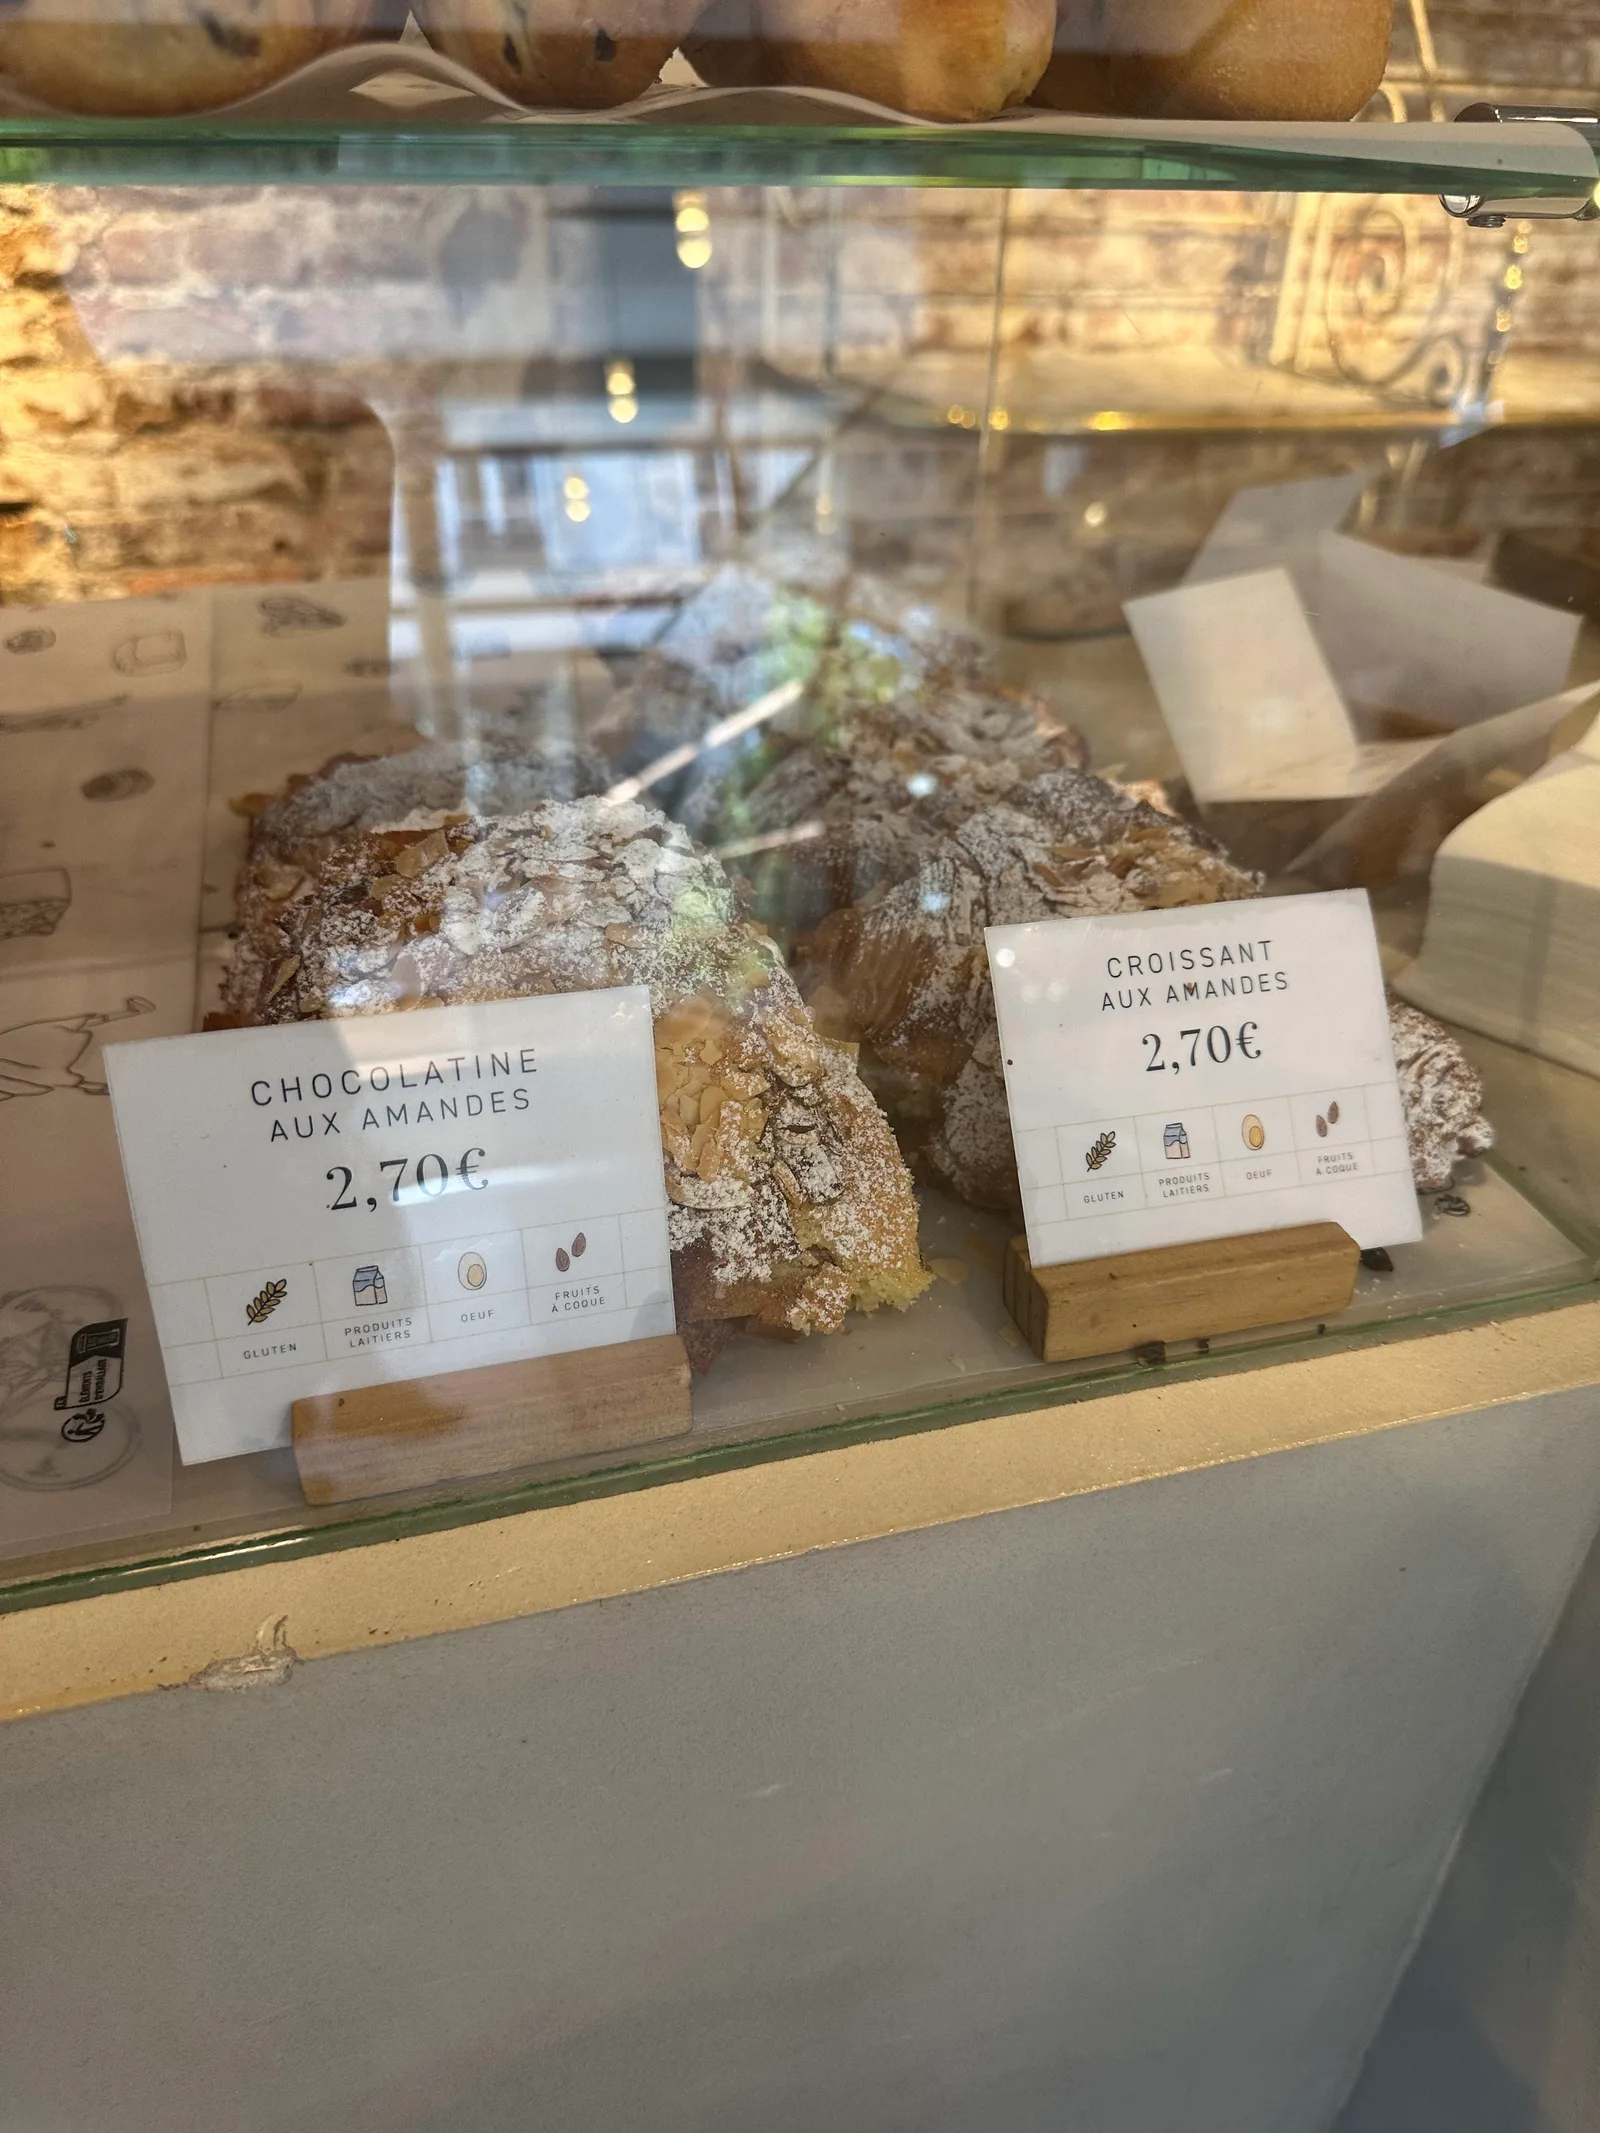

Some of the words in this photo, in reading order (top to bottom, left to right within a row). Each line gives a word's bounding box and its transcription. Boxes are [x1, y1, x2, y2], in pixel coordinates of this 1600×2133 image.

[1107, 940, 1272, 978] CROISSANT
[1101, 987, 1152, 1011] AUX
[1166, 972, 1288, 1004] AMANDES
[1141, 1021, 1262, 1075] 2,70€
[251, 1048, 538, 1106] CHOCOLATINE
[270, 1112, 341, 1142] AUX
[362, 1088, 531, 1130] AMANDES
[1317, 1151, 1353, 1164] FRUITS
[1246, 1168, 1273, 1181] OEUF
[1325, 1162, 1358, 1175] COQUE
[326, 1147, 489, 1212] 2,70€
[1158, 1172, 1210, 1187] PRODUITS
[1083, 1190, 1125, 1204] GLUTEN
[1163, 1183, 1210, 1199] LAITIERS
[554, 1285, 600, 1301] FRUITS
[564, 1296, 605, 1311] COQUE
[461, 1309, 495, 1323] OEUF
[344, 1317, 413, 1336] PRODUITS
[349, 1330, 411, 1348] LAITIERS
[243, 1343, 298, 1360] GLUTEN
